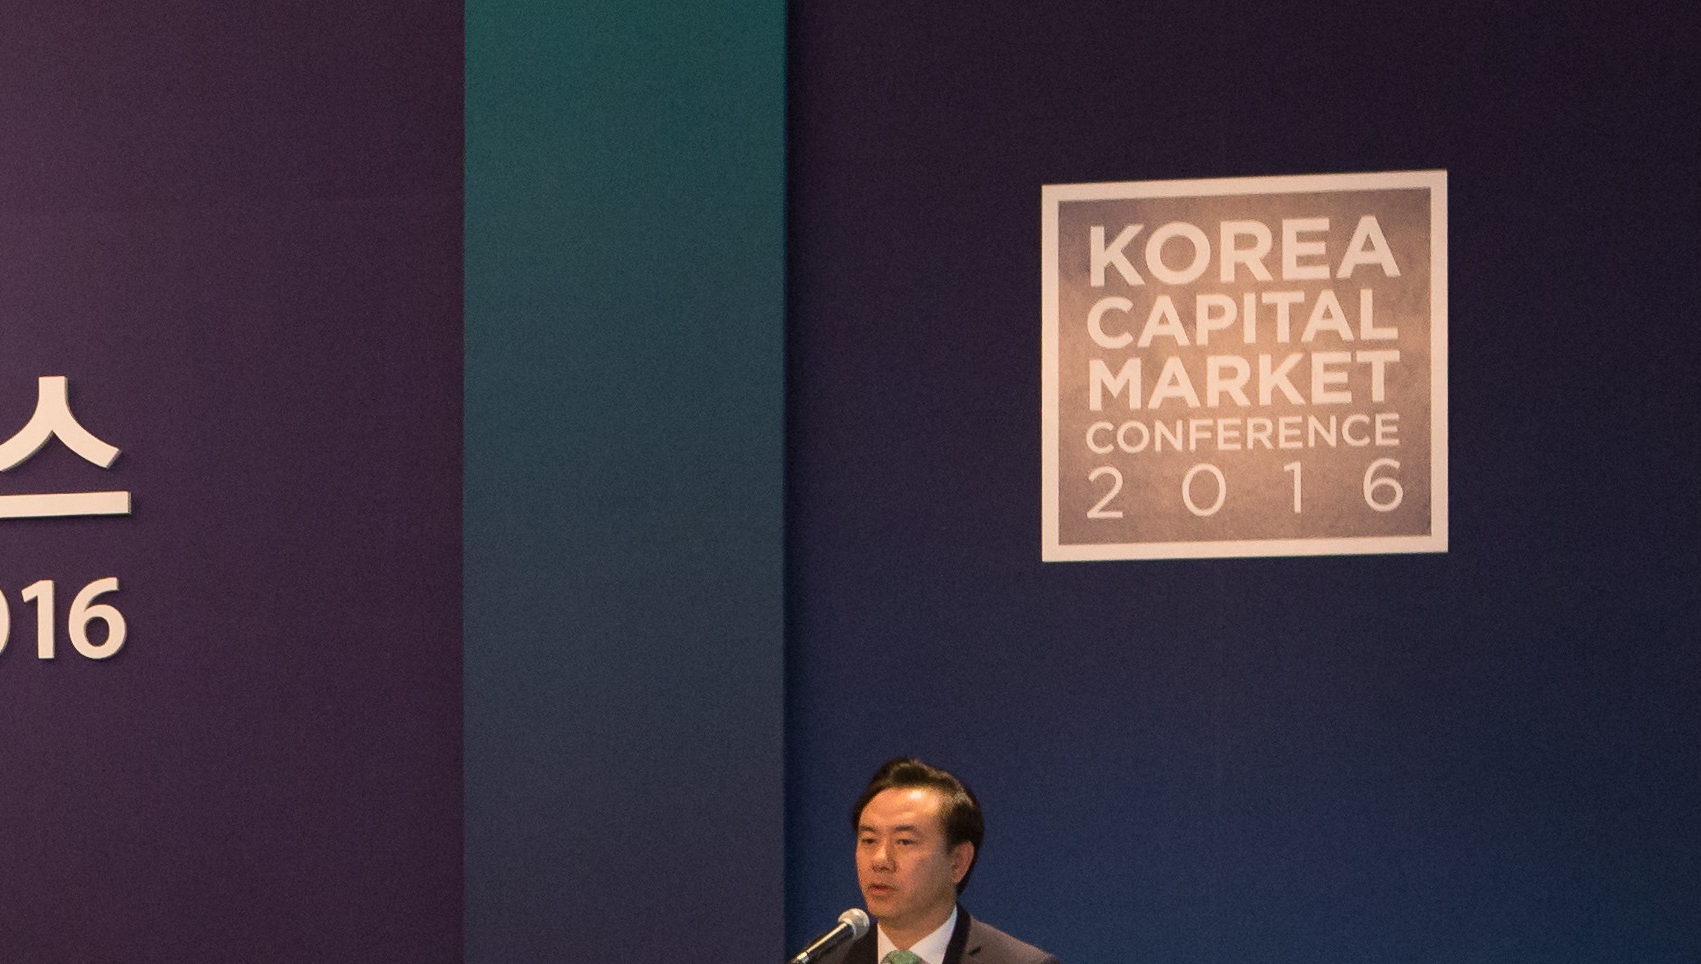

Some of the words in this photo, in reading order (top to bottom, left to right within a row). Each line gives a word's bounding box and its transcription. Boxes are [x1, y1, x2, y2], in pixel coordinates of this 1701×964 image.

[1089, 215, 1401, 287] KOREA
[1086, 289, 1399, 349] CAPITAL
[1088, 350, 1400, 411] MARKET
[1085, 413, 1400, 454] CONFERENCE
